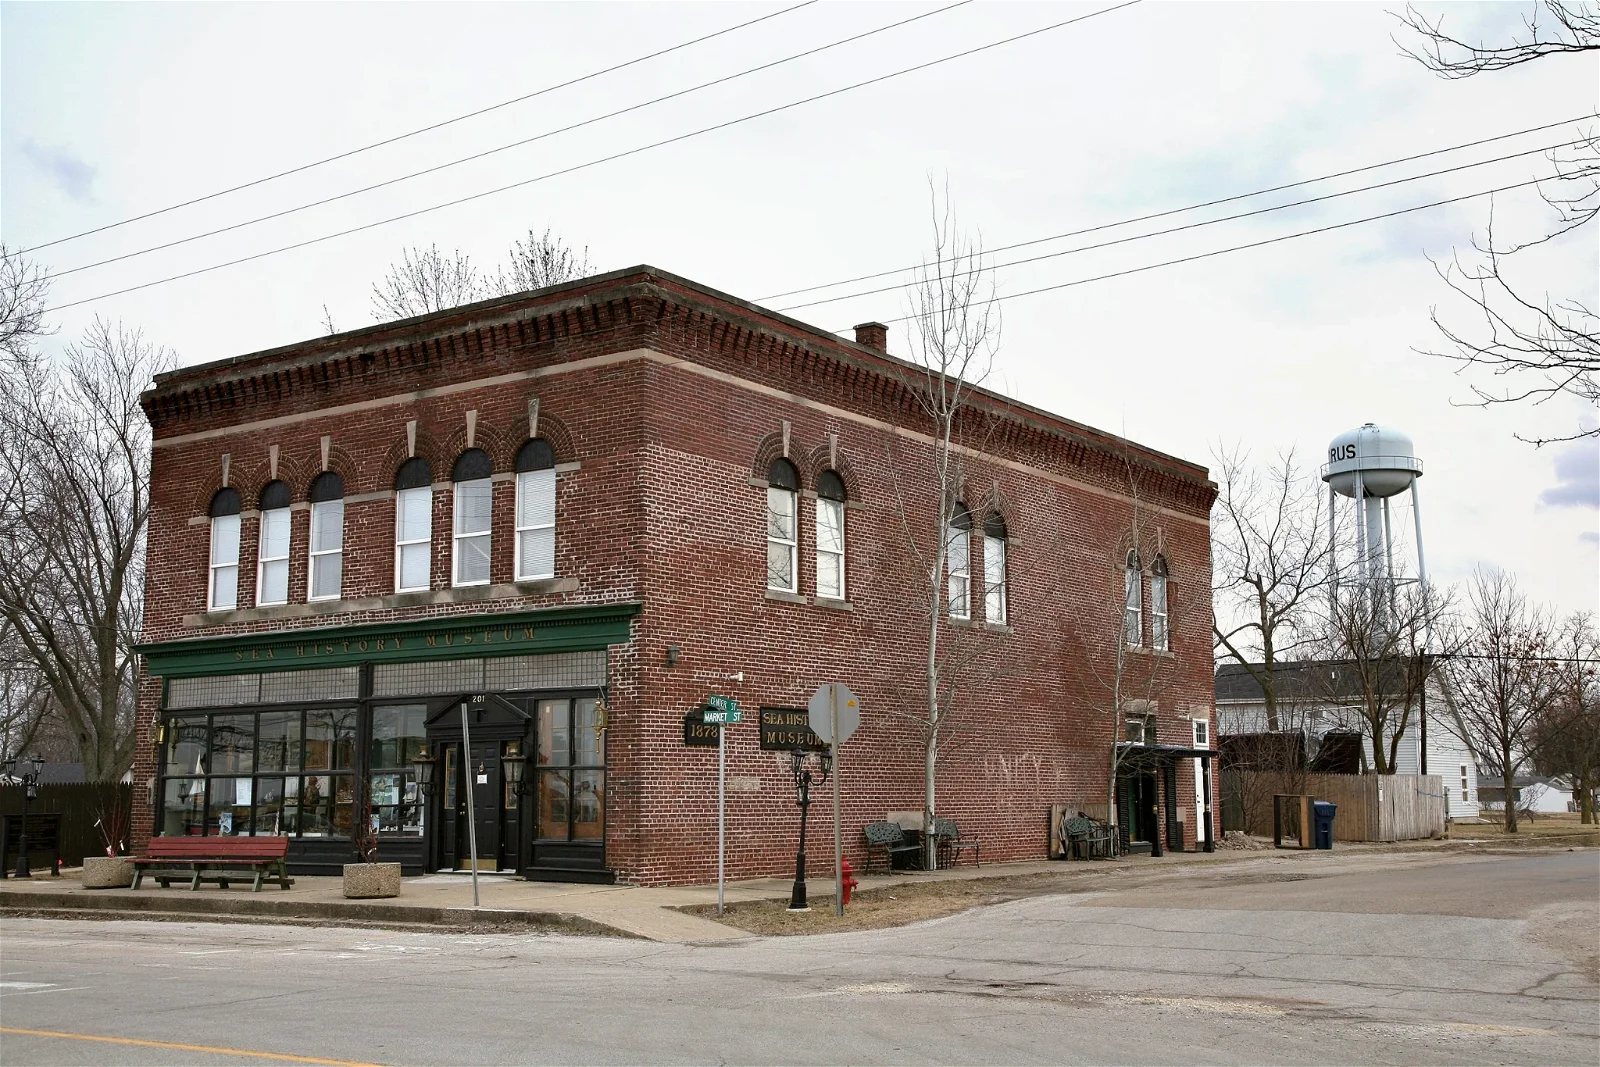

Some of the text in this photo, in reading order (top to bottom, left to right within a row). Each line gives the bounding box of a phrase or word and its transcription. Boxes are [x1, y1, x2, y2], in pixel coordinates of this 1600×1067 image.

[1328, 444, 1356, 463] RUS
[236, 627, 535, 661] SEA HISTORY MUSEUM
[704, 712, 741, 722] MARKET ST
[763, 712, 809, 726] SEA HIST
[691, 724, 718, 738] 1878
[767, 731, 822, 745] MUSEUM
